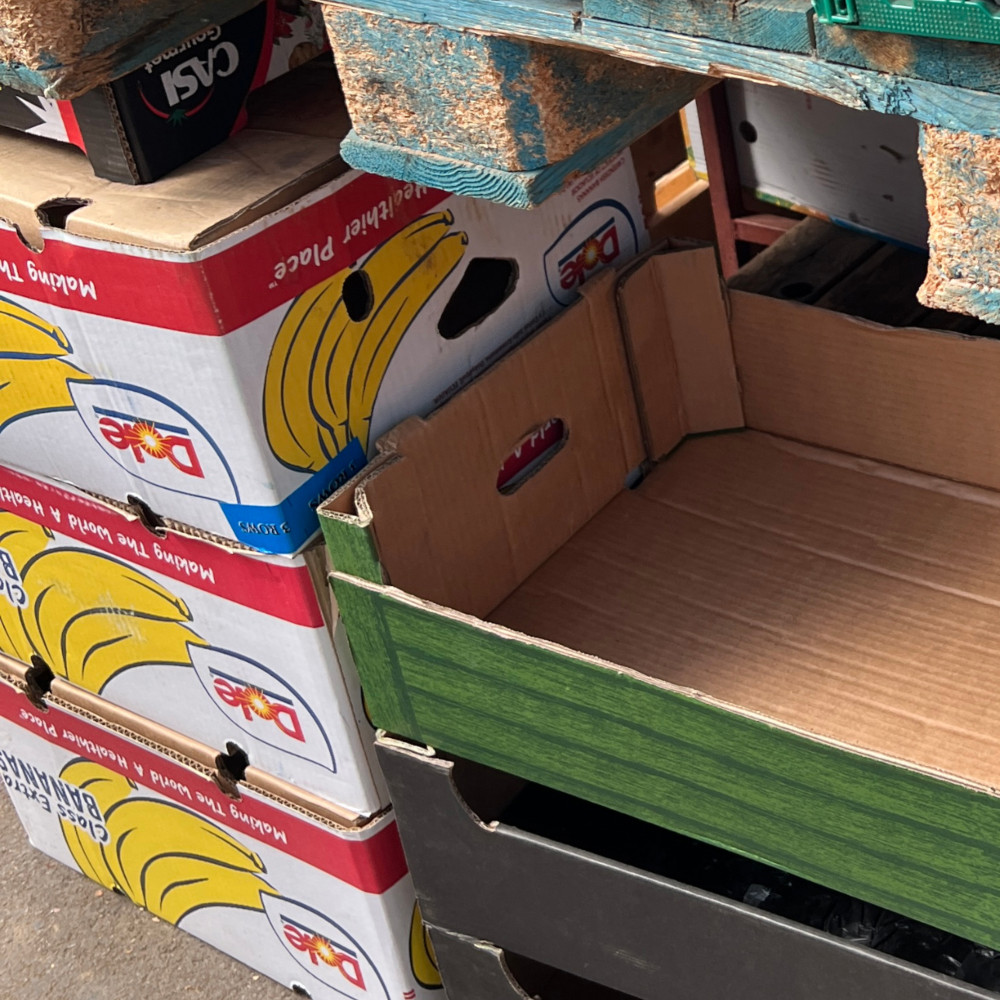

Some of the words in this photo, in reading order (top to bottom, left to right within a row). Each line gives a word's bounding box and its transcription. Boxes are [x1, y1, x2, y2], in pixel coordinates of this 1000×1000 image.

[160, 41, 239, 106] CASI
[27, 262, 97, 301] Making
[98, 416, 206, 480] Dole
[50, 506, 62, 523] A
[68, 512, 115, 542] World
[238, 520, 279, 536] ROWS
[115, 534, 151, 561] The
[152, 542, 217, 585] Making
[213, 677, 306, 743] Dole
[62, 728, 129, 770] Healthier
[134, 763, 144, 778] A
[148, 769, 195, 801] World
[5, 773, 52, 814] Extra
[195, 790, 227, 818] The
[56, 809, 109, 843] Class
[228, 803, 289, 845] Making
[283, 924, 368, 992] Dole
